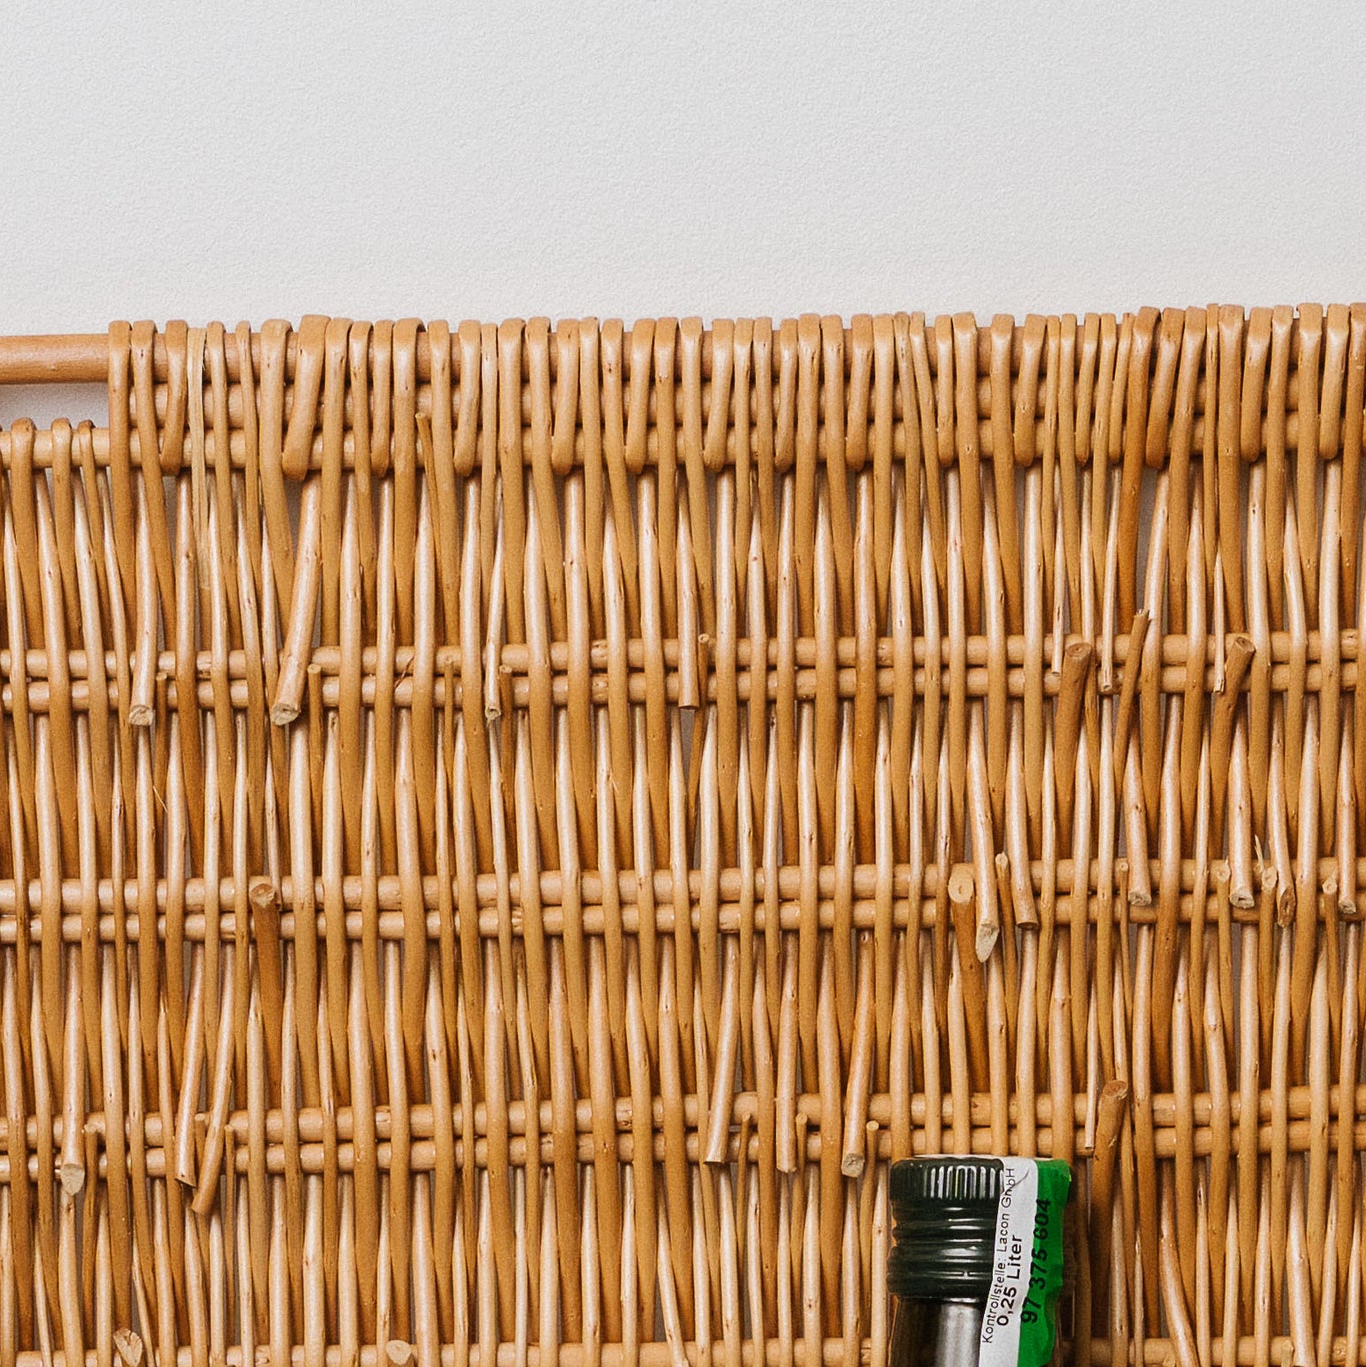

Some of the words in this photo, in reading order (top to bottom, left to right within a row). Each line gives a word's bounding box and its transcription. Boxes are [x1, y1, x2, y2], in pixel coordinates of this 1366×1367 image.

[1001, 1168, 1016, 1208] GmbH
[997, 1212, 1010, 1253] Lacon
[1034, 1199, 1051, 1241] 604
[996, 1286, 1018, 1327] 0,25
[1007, 1235, 1023, 1280] Liter
[1029, 1248, 1048, 1290] 375
[982, 1258, 1007, 1344] Kontrollstelle:
[1020, 1295, 1042, 1324] 97
